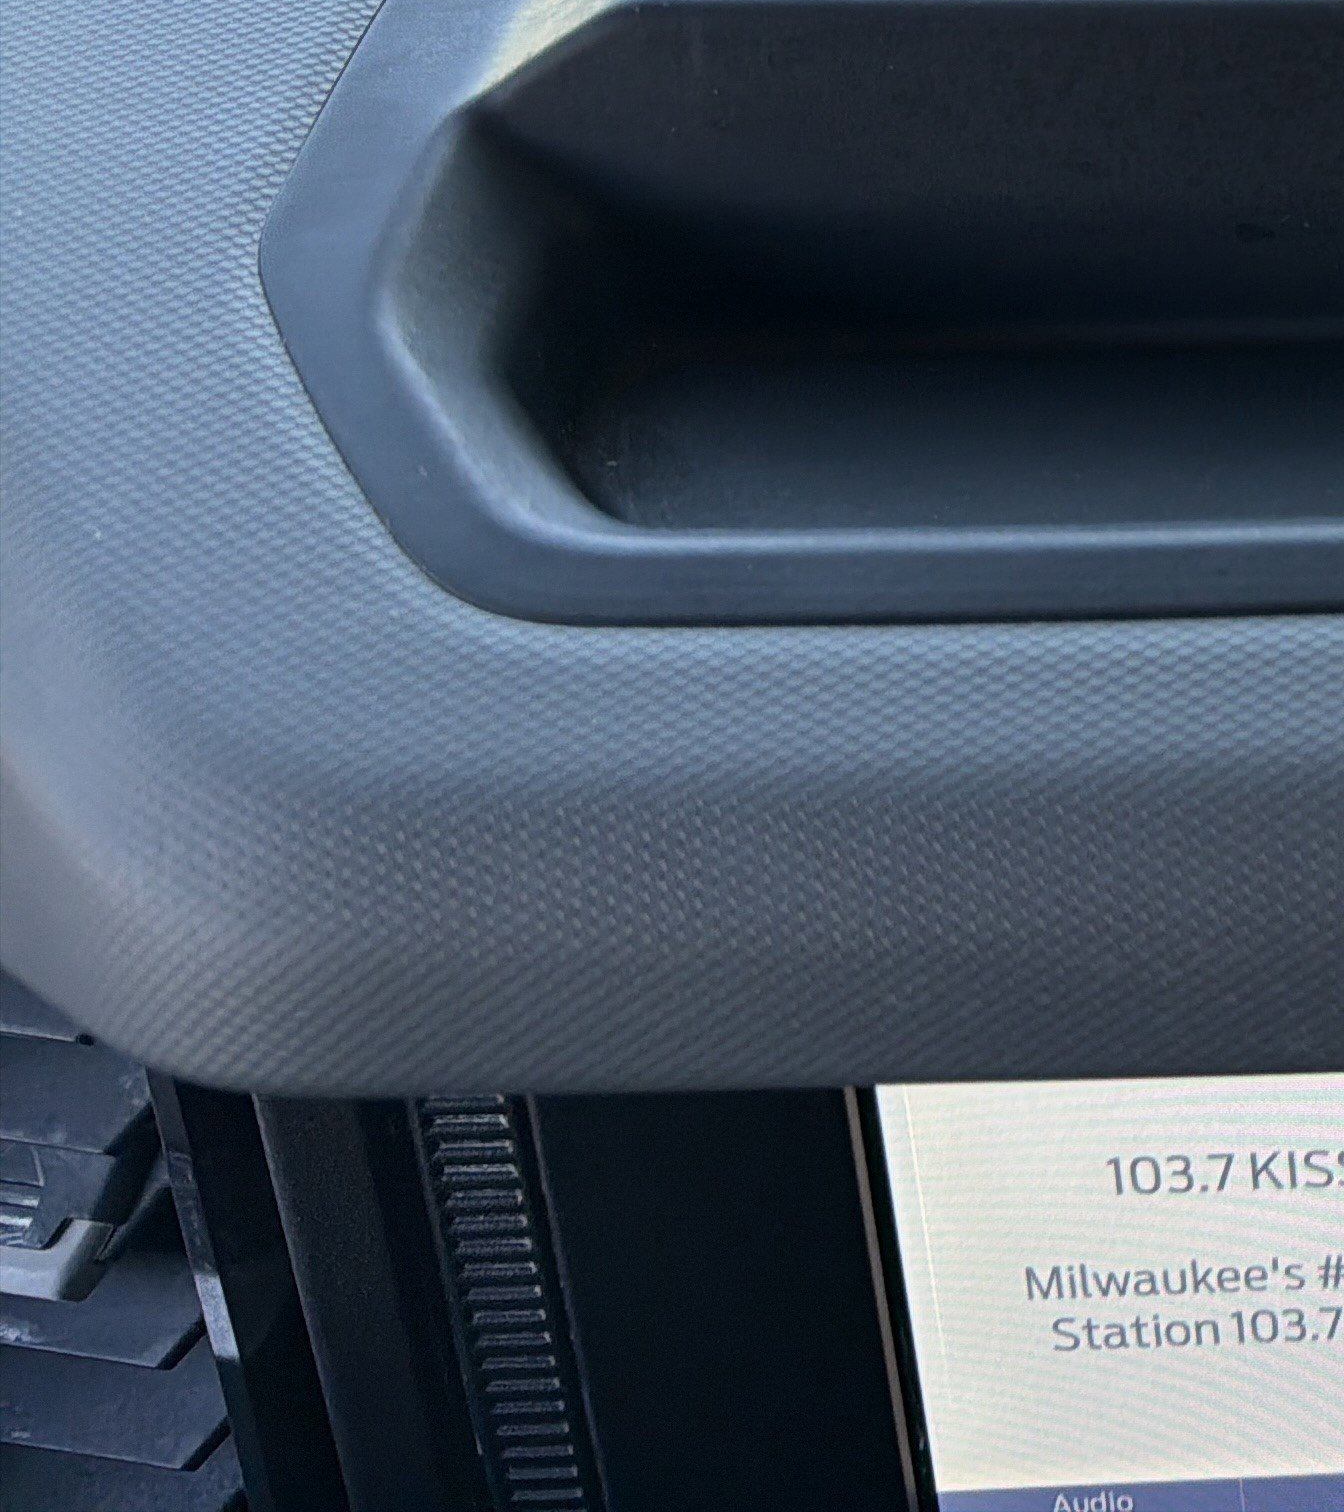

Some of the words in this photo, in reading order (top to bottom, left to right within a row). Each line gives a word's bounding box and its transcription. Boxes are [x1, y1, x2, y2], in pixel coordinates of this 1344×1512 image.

[1106, 1152, 1234, 1195] 103.7
[1025, 1257, 1305, 1300] Milwaukee's
[1052, 1313, 1221, 1352] Station
[1230, 1305, 1342, 1345] 103.7
[1053, 1490, 1134, 1512] Audio
